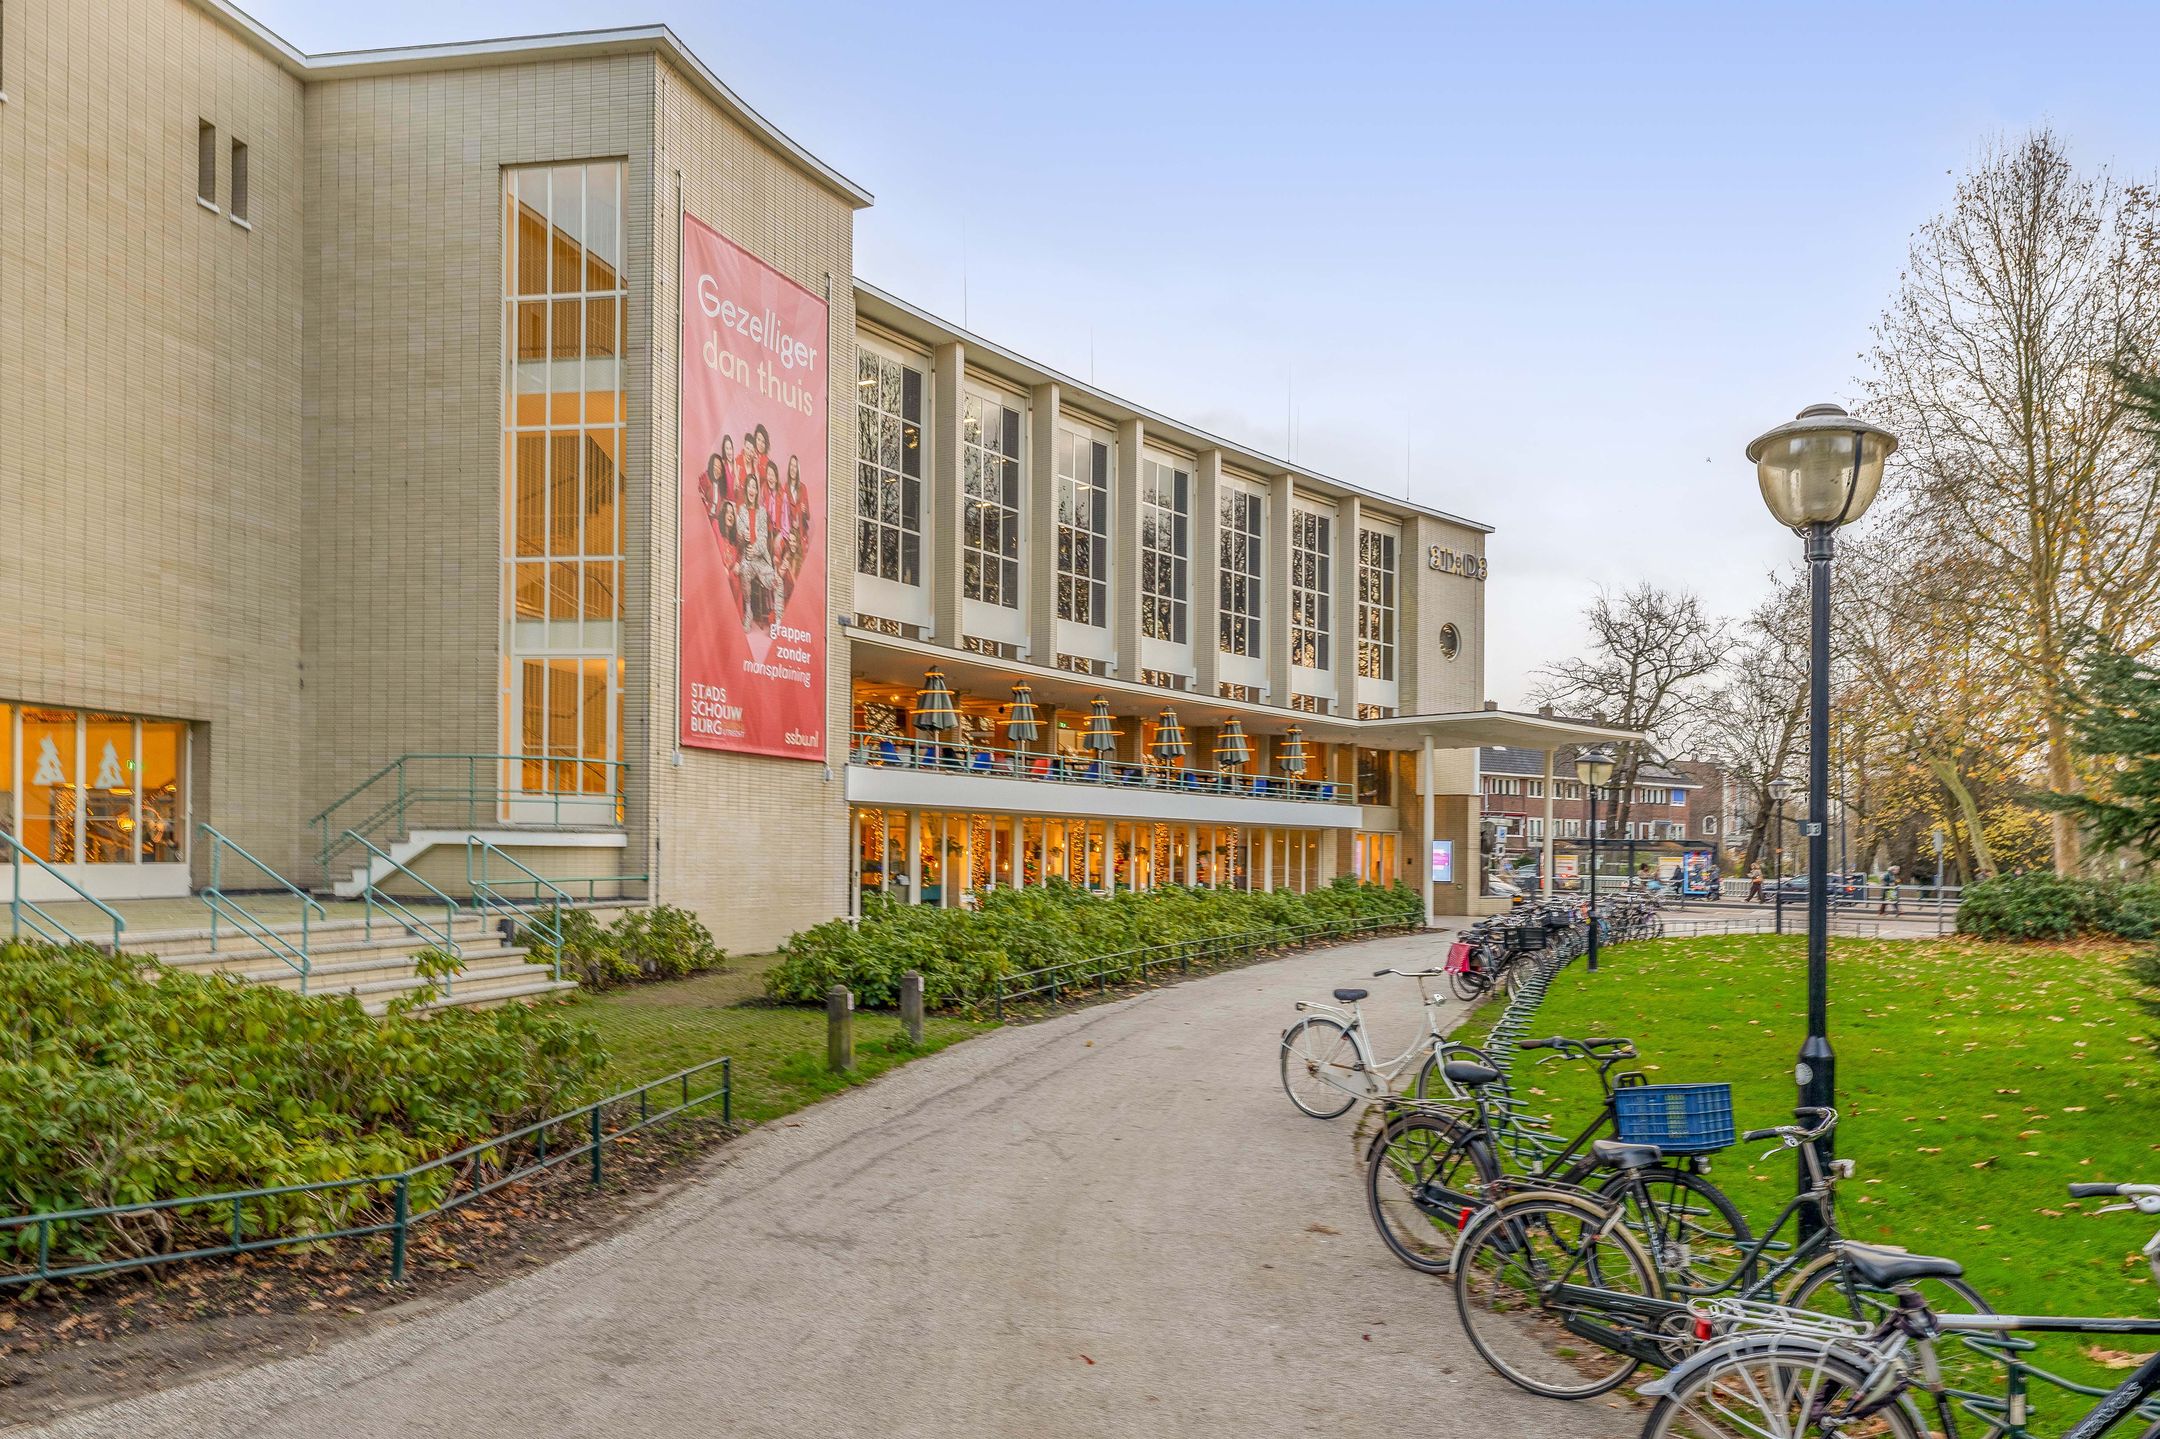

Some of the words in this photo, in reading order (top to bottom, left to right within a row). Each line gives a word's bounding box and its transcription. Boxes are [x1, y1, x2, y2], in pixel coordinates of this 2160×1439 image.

[697, 274, 818, 371] Gezelliger
[702, 330, 750, 388] dan
[757, 360, 813, 416] thuis
[769, 623, 811, 643] grappen
[776, 646, 811, 664] zonder
[743, 659, 811, 688] mansplaining
[691, 683, 727, 703] STADS
[691, 700, 743, 721] SCHOUW
[691, 716, 722, 735] BURG
